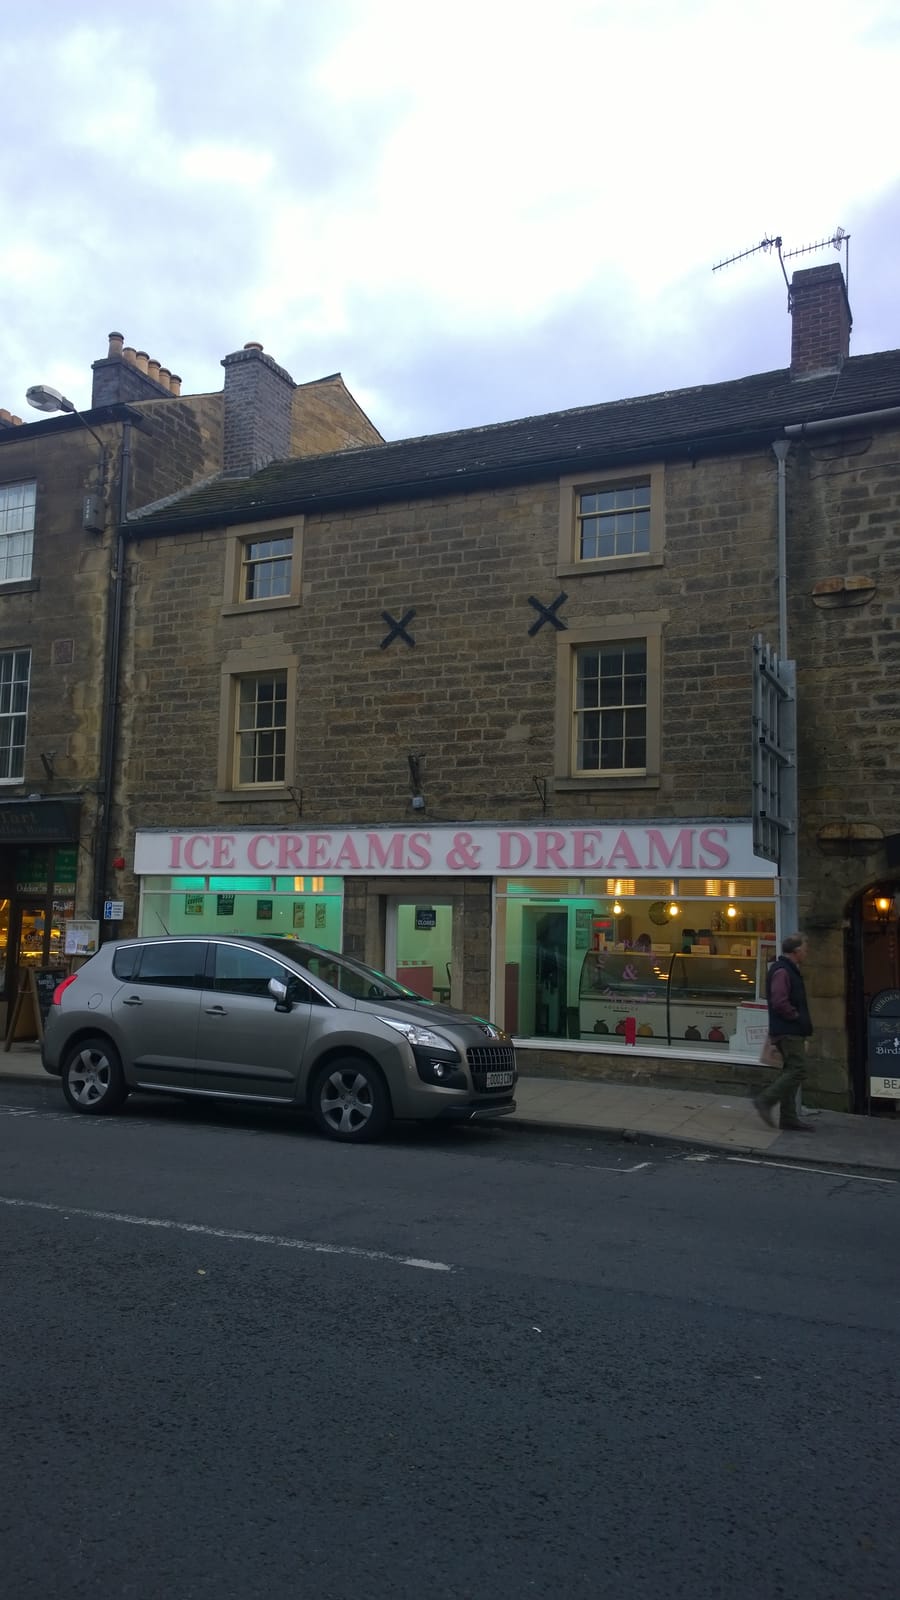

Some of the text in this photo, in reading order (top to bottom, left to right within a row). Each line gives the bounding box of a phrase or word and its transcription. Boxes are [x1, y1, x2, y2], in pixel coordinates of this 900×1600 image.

[169, 828, 730, 870] ICE CREAMS & DREAMS
